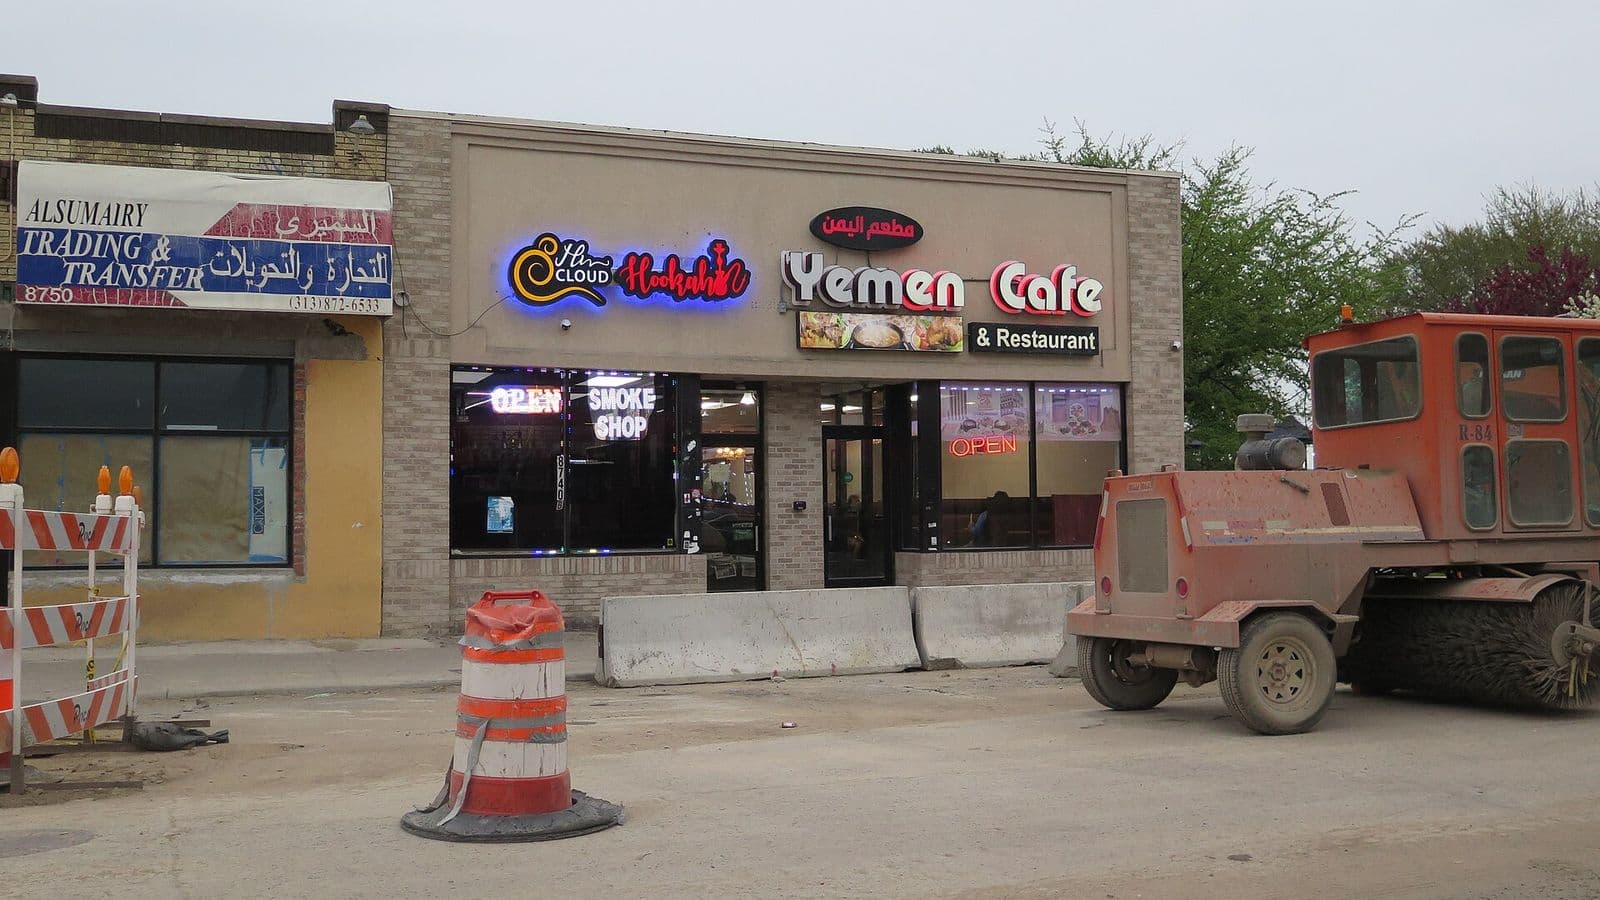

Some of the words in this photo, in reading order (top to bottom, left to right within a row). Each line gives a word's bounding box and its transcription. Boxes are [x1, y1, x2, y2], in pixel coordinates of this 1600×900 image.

[26, 199, 148, 227] ALSUMAIRY
[822, 215, 865, 237] اليمن
[866, 219, 914, 240] مطعم
[22, 229, 144, 264] TRADING
[151, 234, 172, 264] &
[61, 261, 204, 290] TRANSFER
[555, 268, 609, 284] CLOUD
[619, 254, 747, 297] Hookah
[781, 251, 965, 311] Yemen
[990, 260, 1103, 317] Cafe
[24, 286, 73, 304] 8750
[289, 296, 380, 313] (313)872-6533
[976, 327, 991, 347] &
[996, 327, 1096, 350] Restaurant
[489, 387, 562, 414] OPEN
[589, 387, 656, 411] SMOKE
[596, 415, 648, 440] SHOP
[951, 434, 1018, 458] OPEN
